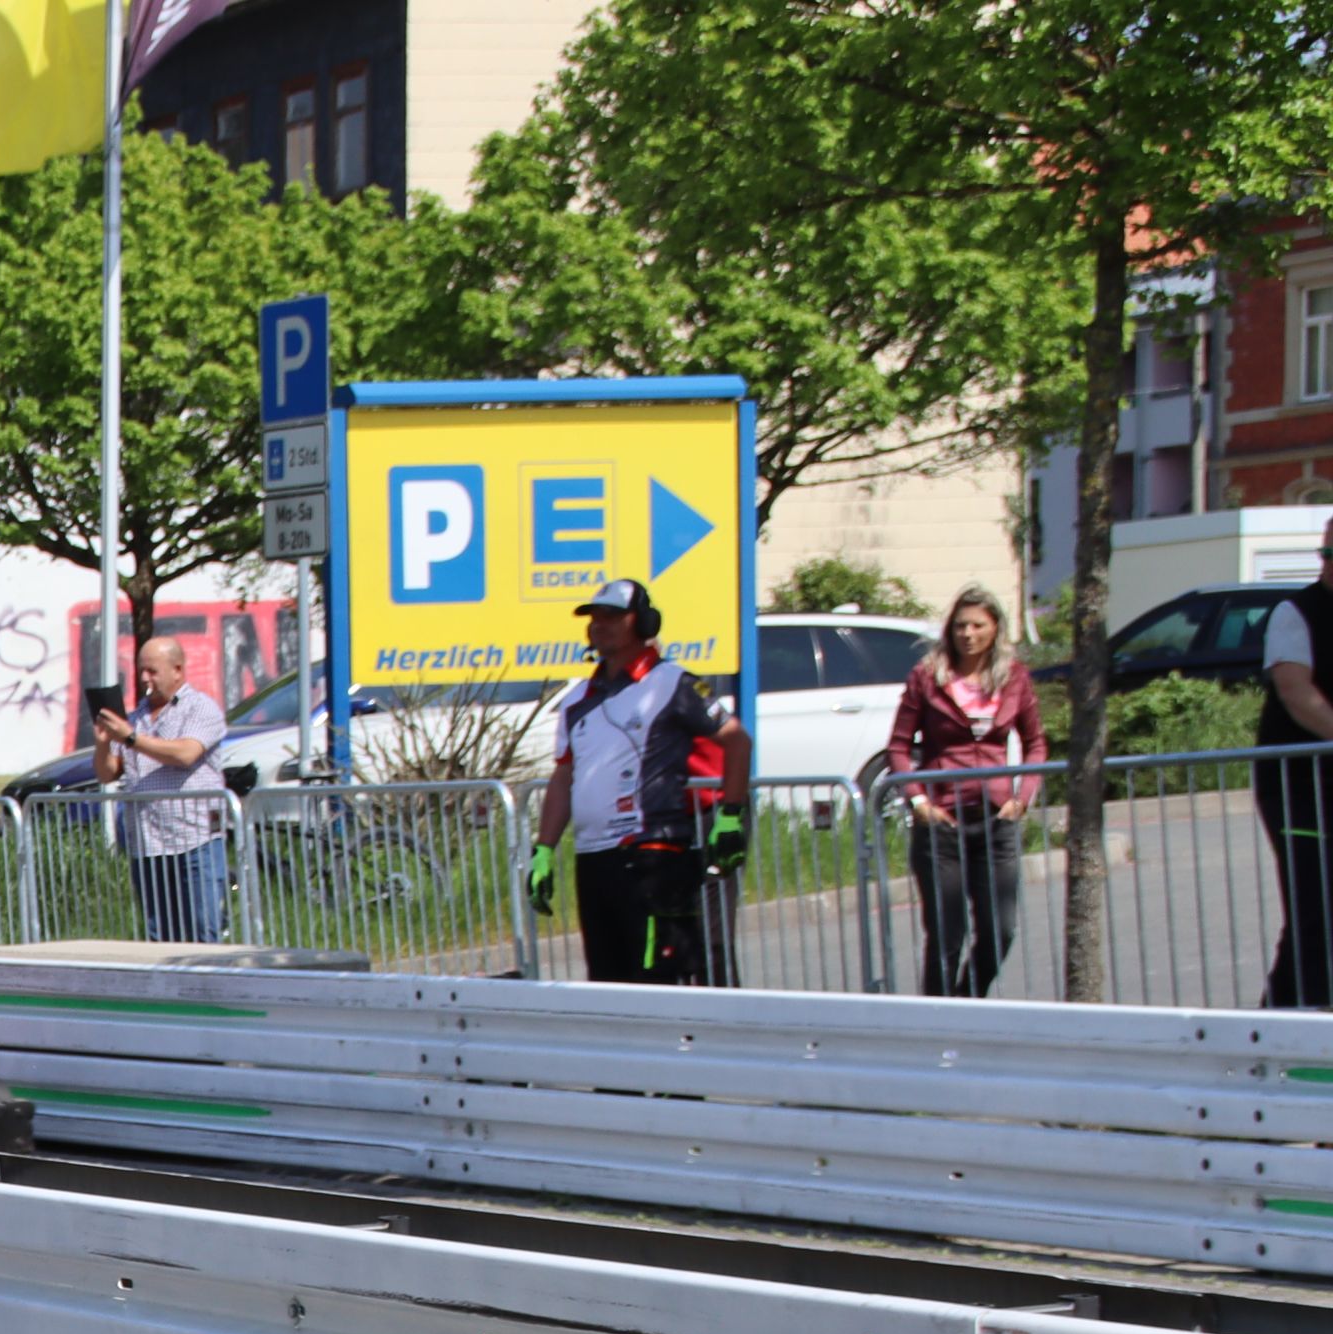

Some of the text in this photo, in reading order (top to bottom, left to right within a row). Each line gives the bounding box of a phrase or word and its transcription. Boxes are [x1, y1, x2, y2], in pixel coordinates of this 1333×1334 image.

[276, 316, 311, 407] P
[276, 502, 312, 523] Mo-Sa
[401, 479, 473, 590] P
[532, 477, 605, 564] E
[532, 571, 606, 588] EDEKA
[375, 638, 717, 671] Herzlich Willken!
